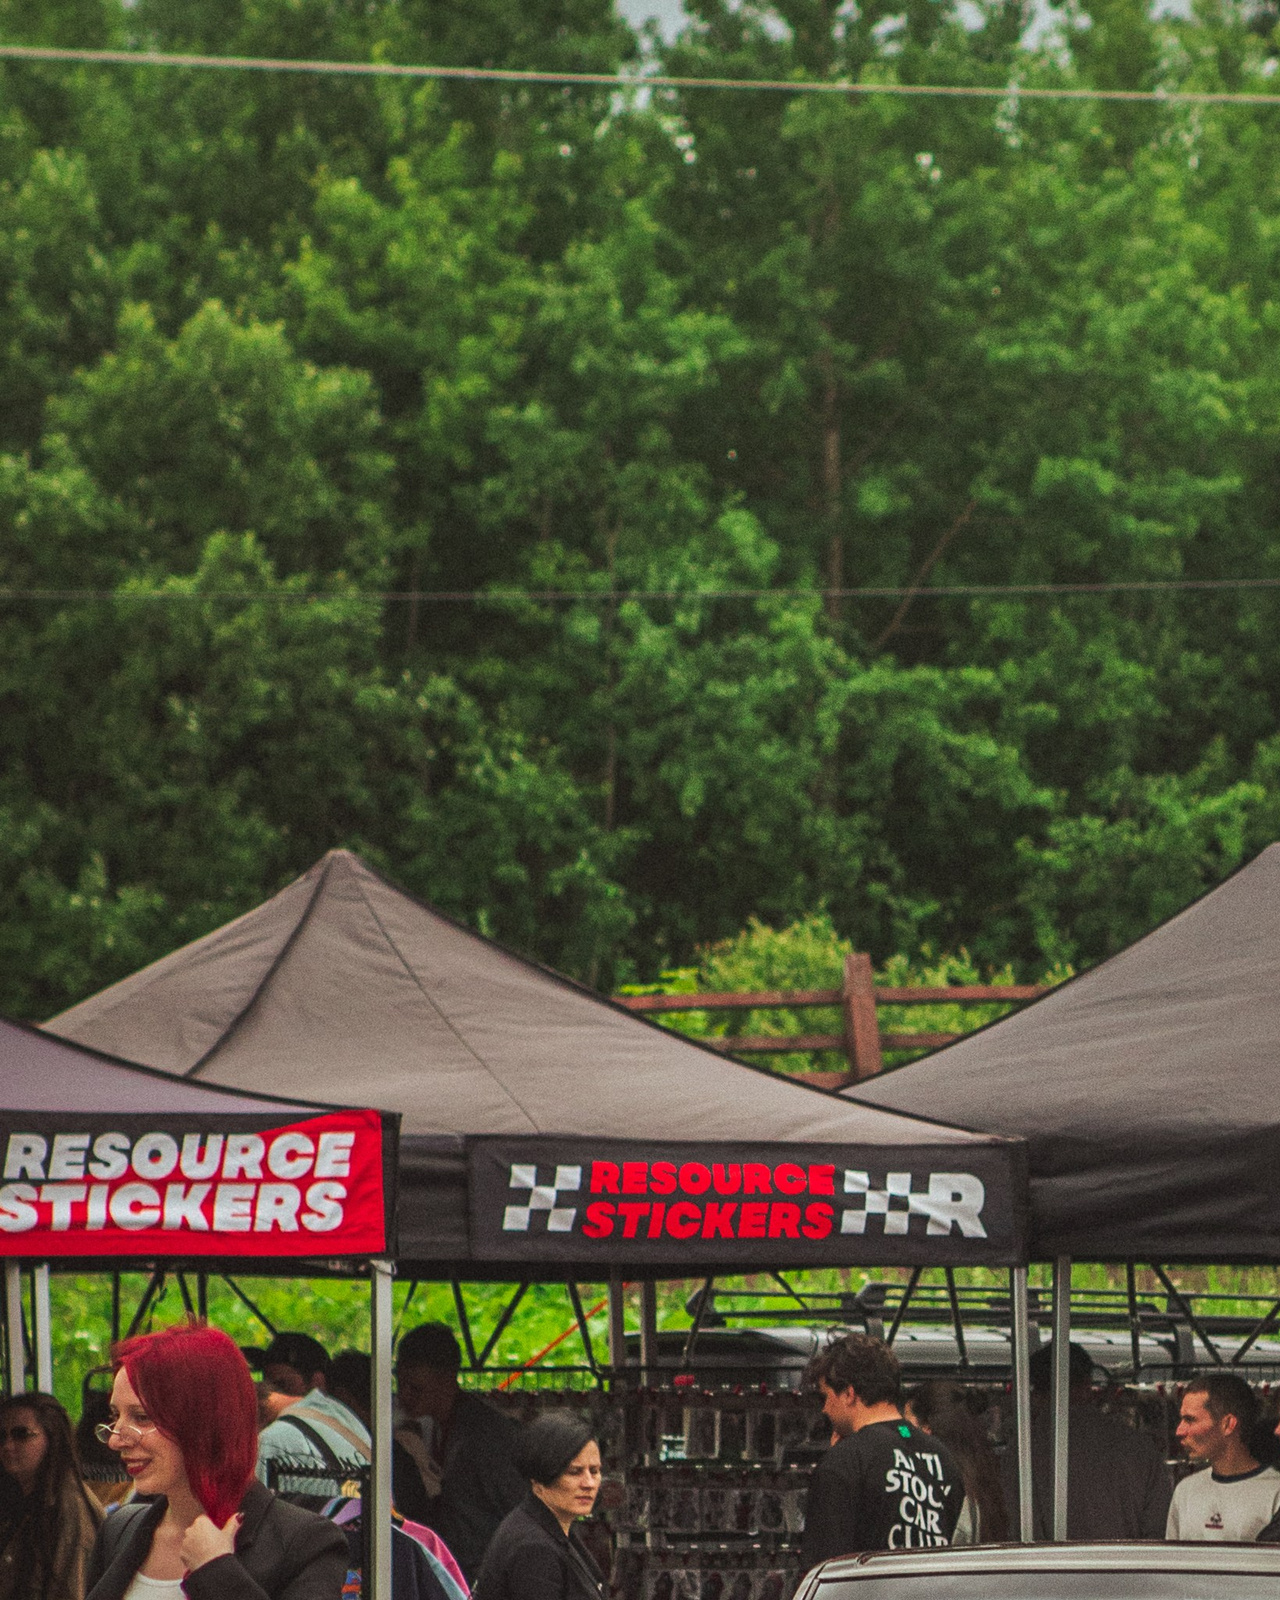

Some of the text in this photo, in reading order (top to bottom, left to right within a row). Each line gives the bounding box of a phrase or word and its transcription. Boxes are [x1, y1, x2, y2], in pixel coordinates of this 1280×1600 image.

[3, 1131, 356, 1180] RESOURCE
[590, 1161, 836, 1196] RESOURCE
[0, 1181, 347, 1233] STICKERS
[581, 1201, 834, 1240] STICKERS
[900, 1496, 942, 1534] CAR
